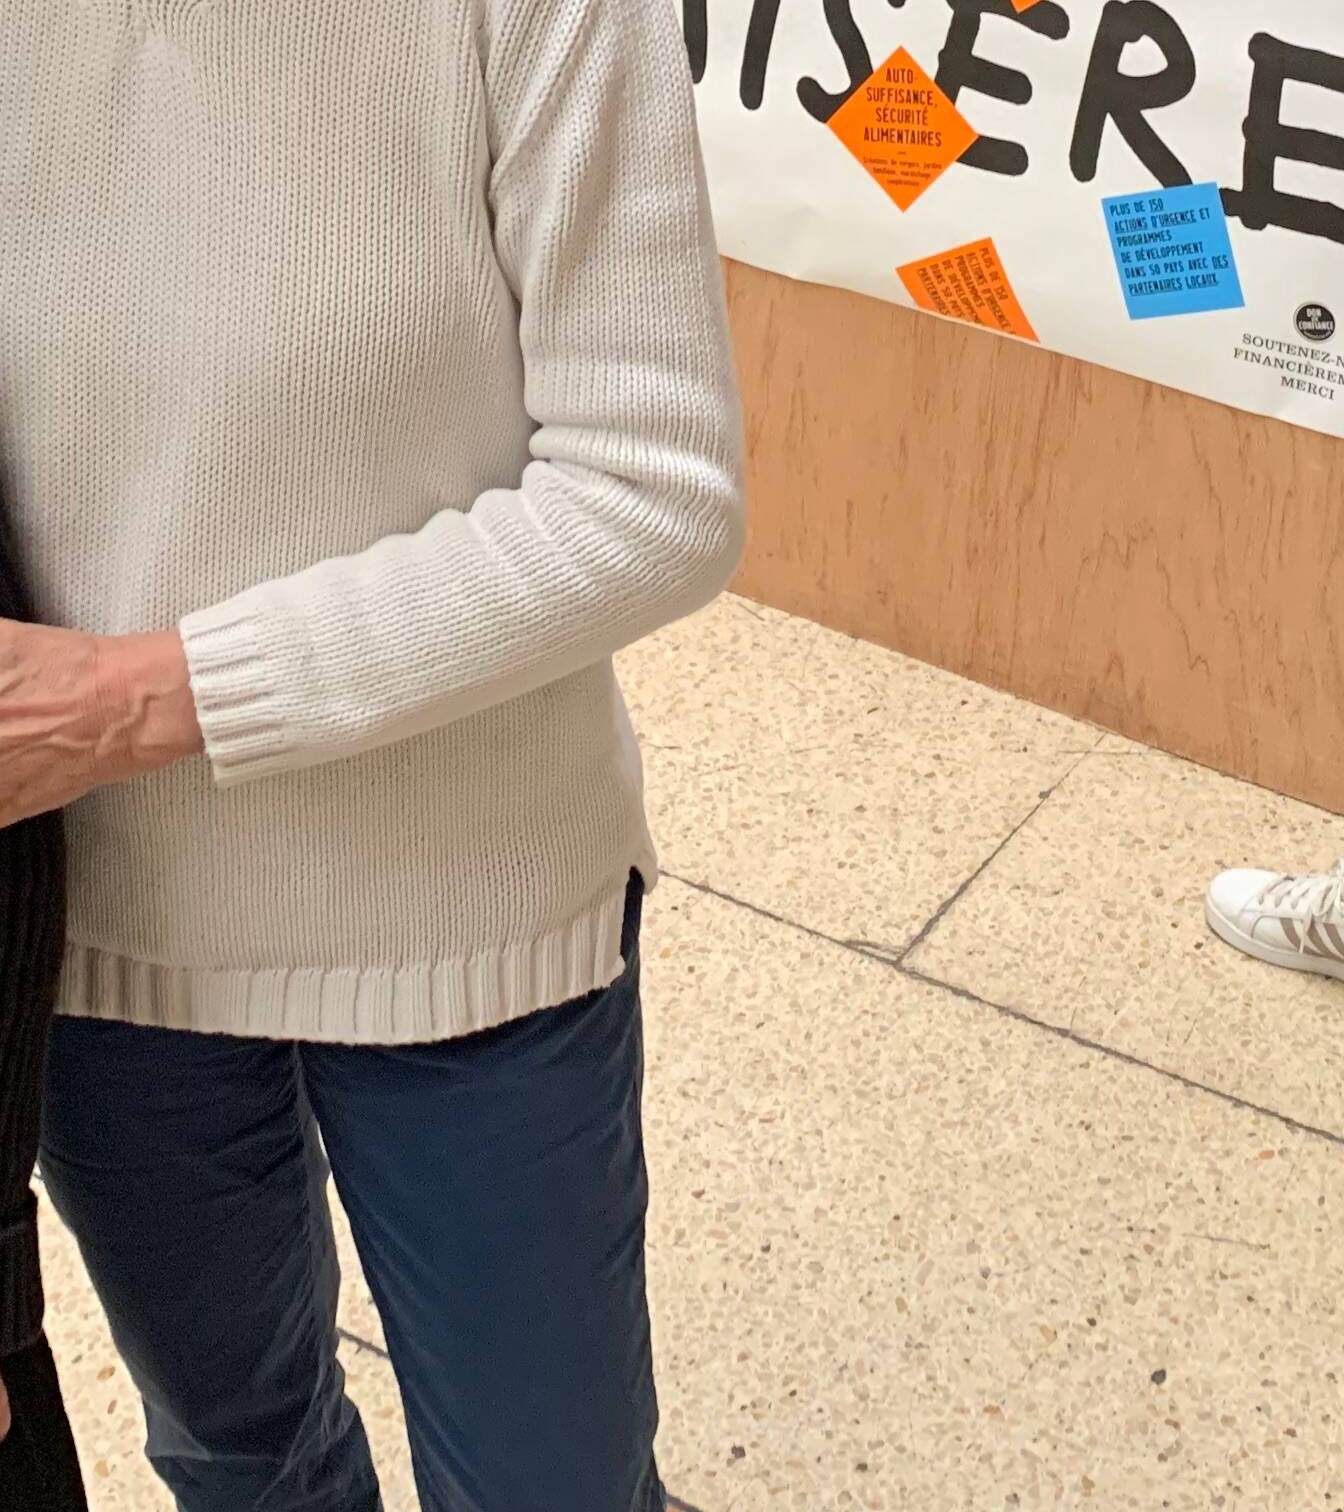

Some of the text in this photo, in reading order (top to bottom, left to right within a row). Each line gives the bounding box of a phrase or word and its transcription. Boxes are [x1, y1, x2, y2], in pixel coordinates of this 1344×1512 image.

[867, 86, 938, 108] SUFFISANCE,
[876, 103, 929, 126] SÉCURITÉ
[864, 126, 942, 147] ALIMENTAIRES
[1109, 197, 1165, 216] PLUS DE 150
[1114, 206, 1211, 233] ACTIONS D'URGENCE ET
[1117, 229, 1173, 247] PROGRAMMES
[1120, 241, 1204, 264] DE DÉVELOPPEMENT
[1125, 254, 1230, 279] DANS 50 PAYS AVEC DES
[1129, 277, 1183, 296] PARTENAIRES
[1281, 375, 1335, 399] MERCI
